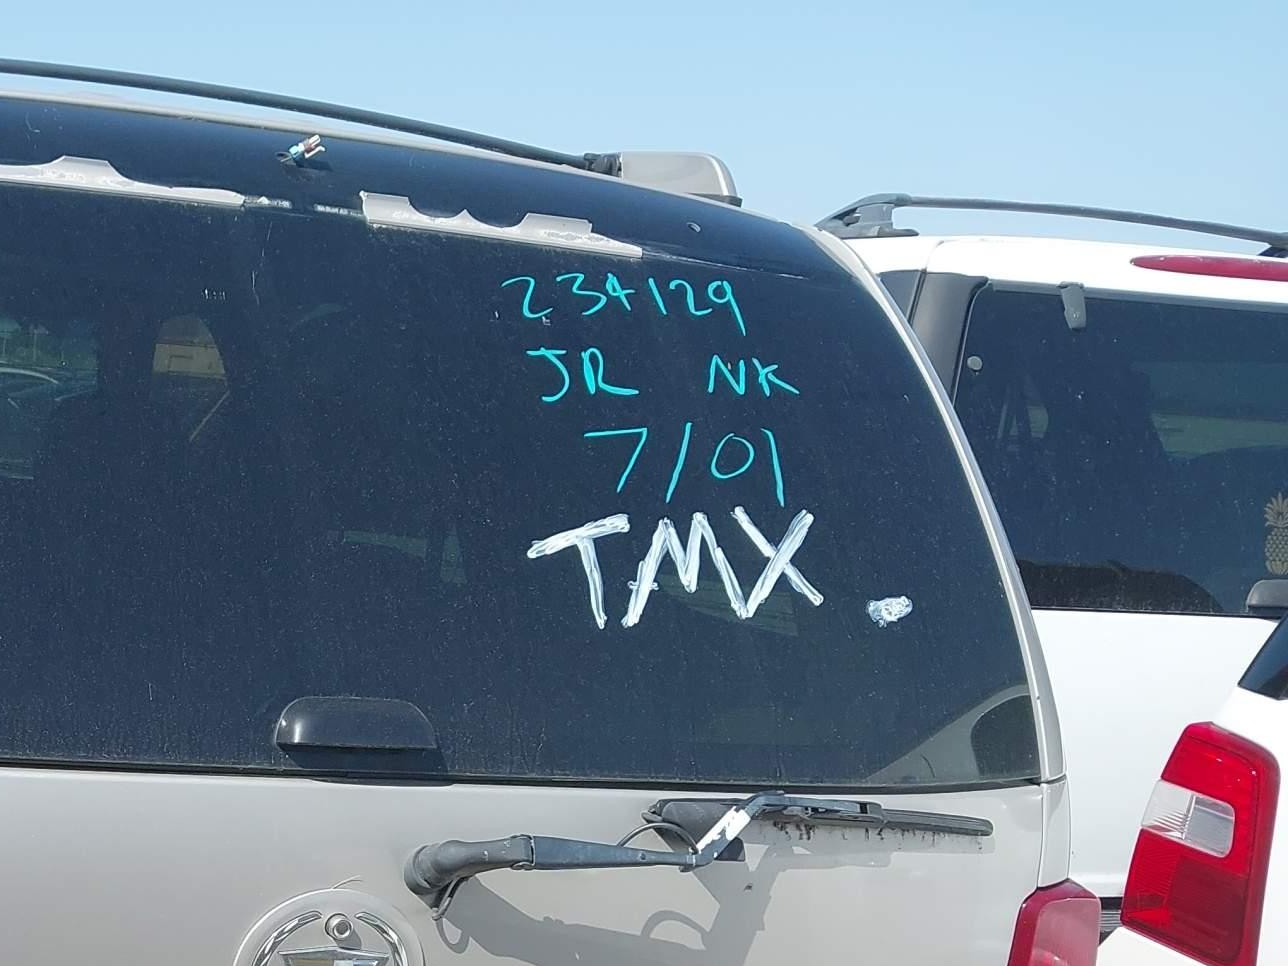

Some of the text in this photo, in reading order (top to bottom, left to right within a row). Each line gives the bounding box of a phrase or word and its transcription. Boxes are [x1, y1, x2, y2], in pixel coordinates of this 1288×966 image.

[527, 347, 801, 402] JR NK
[584, 422, 786, 507] 7/01
[526, 505, 825, 630] TMX
